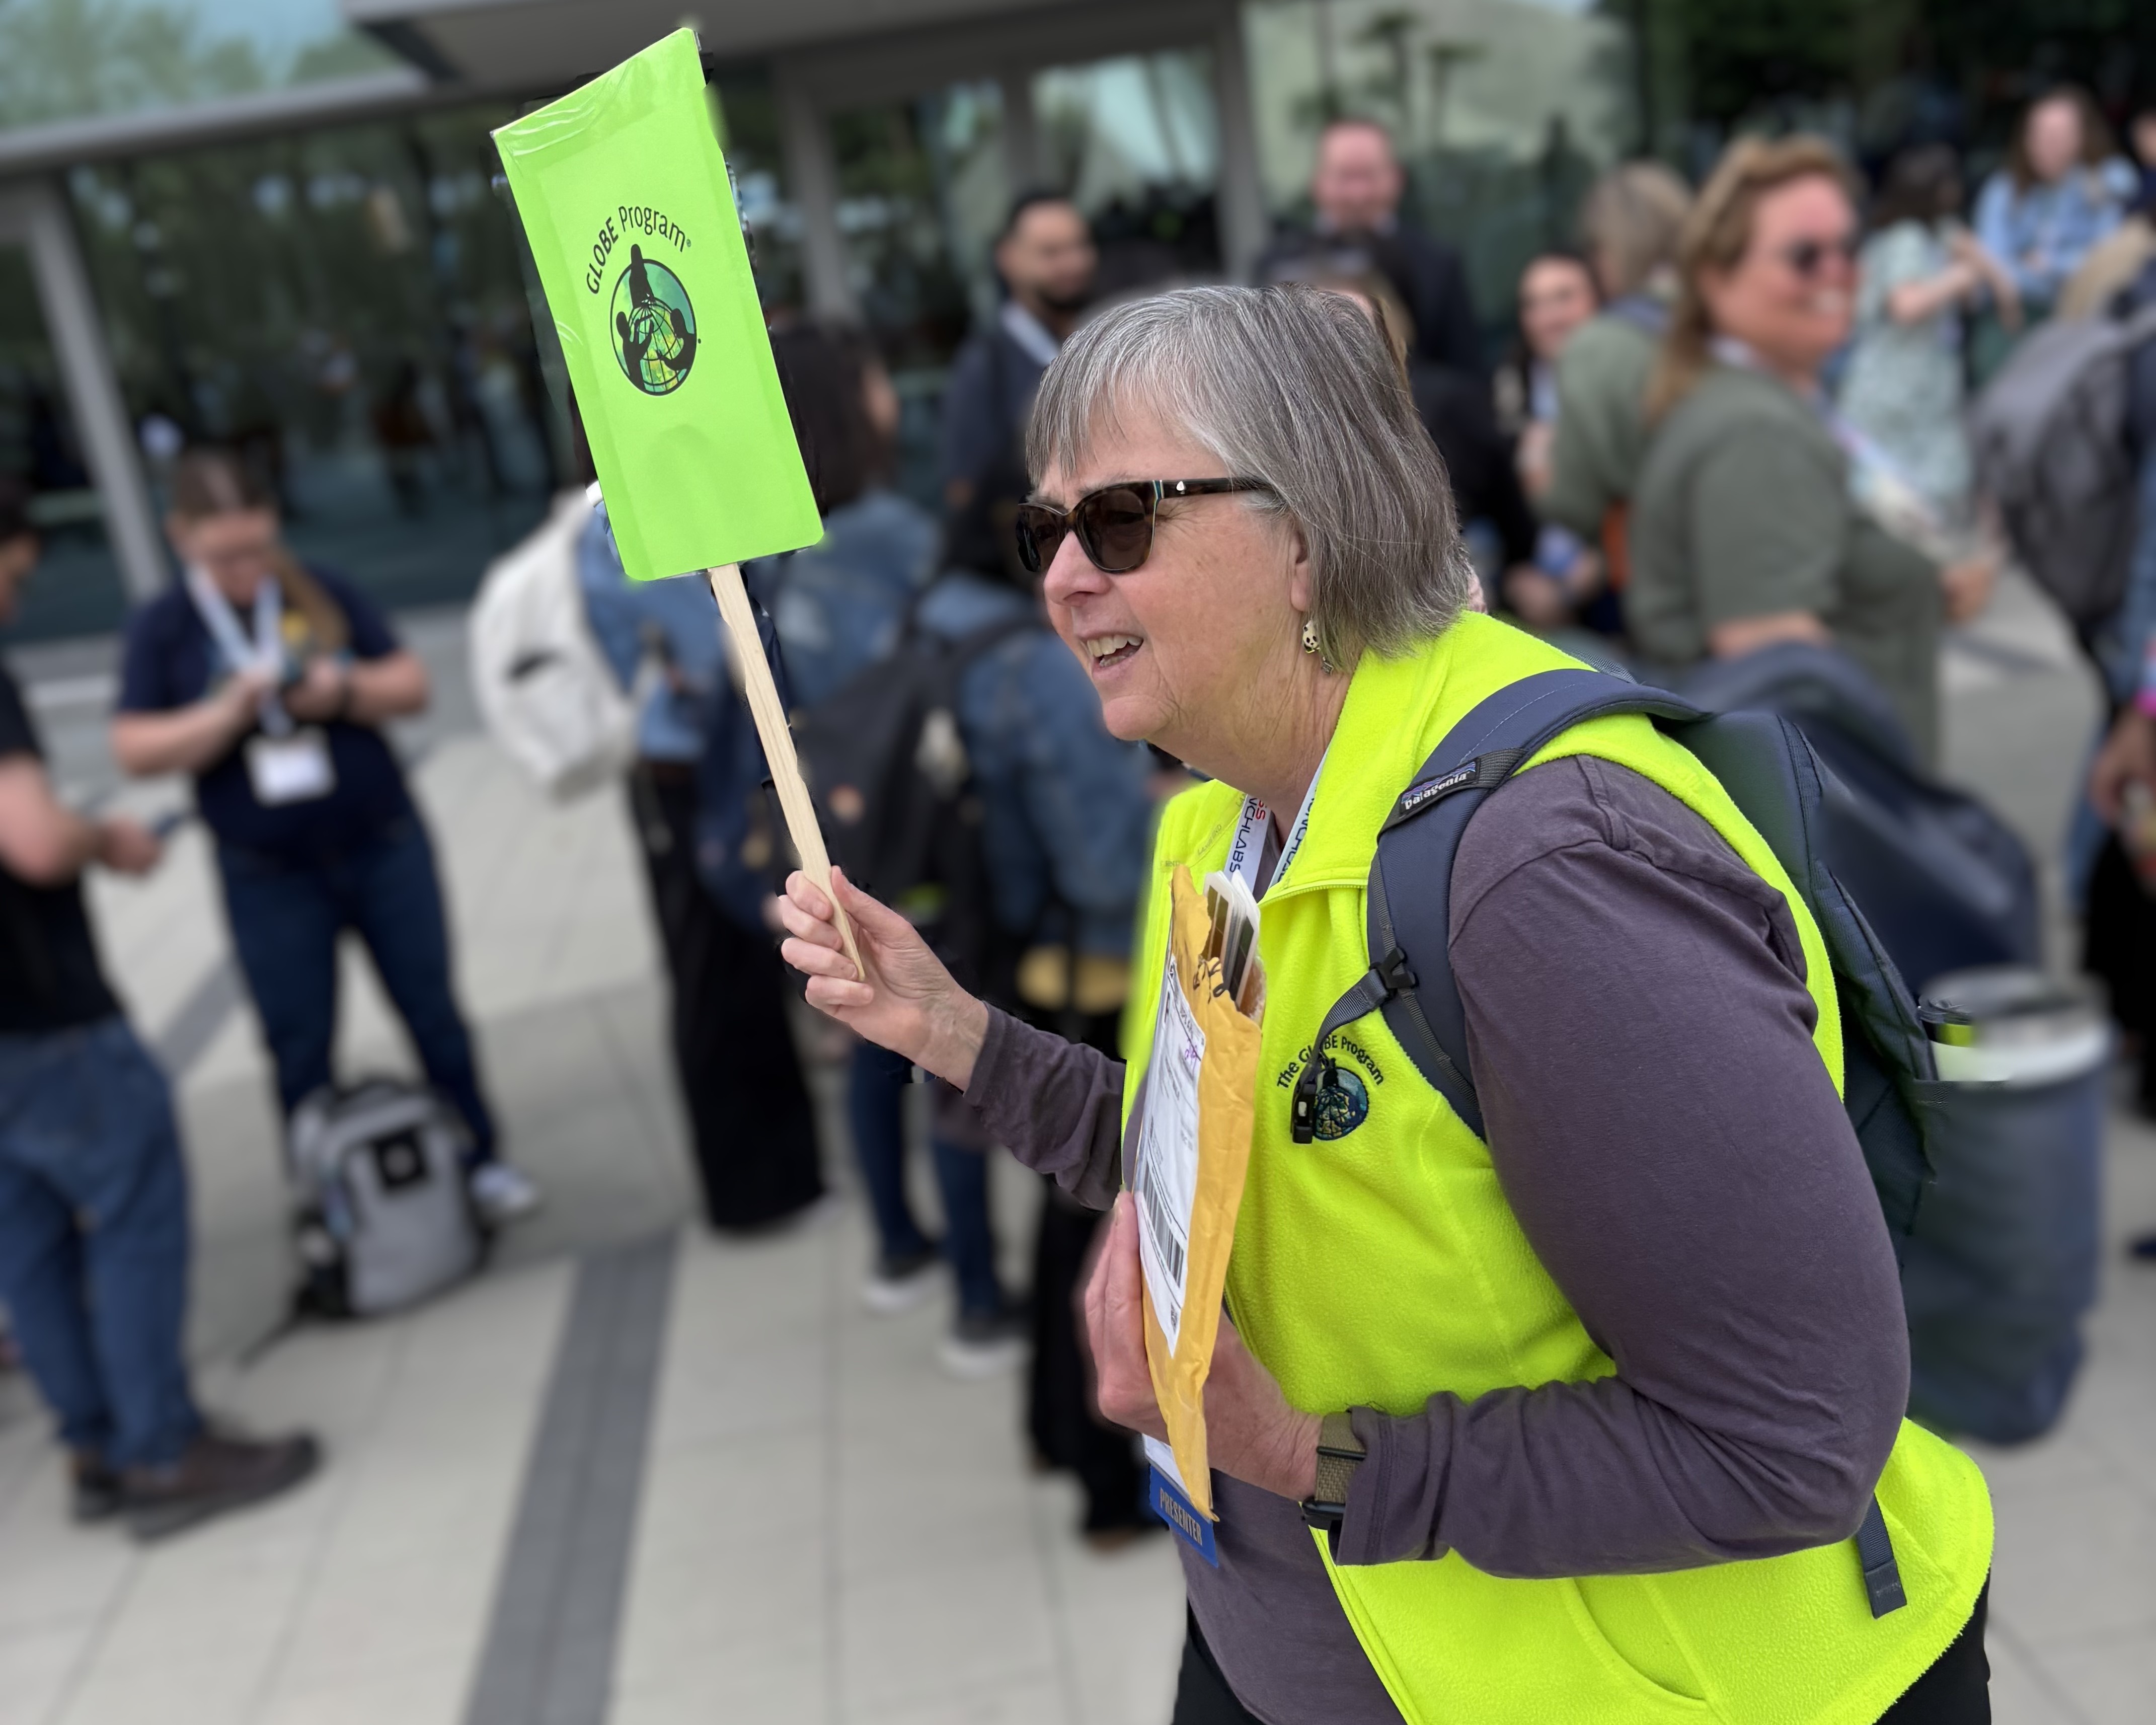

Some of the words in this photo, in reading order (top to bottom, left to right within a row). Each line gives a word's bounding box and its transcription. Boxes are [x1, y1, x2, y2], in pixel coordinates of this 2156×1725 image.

[586, 216, 619, 294] GLOBE
[1405, 772, 1467, 810] patagonia
[1276, 1062, 1300, 1088] The
[1298, 1035, 1338, 1063] GLBE
[1341, 1036, 1384, 1085] Program
[1160, 1487, 1203, 1546] PRESENTER
